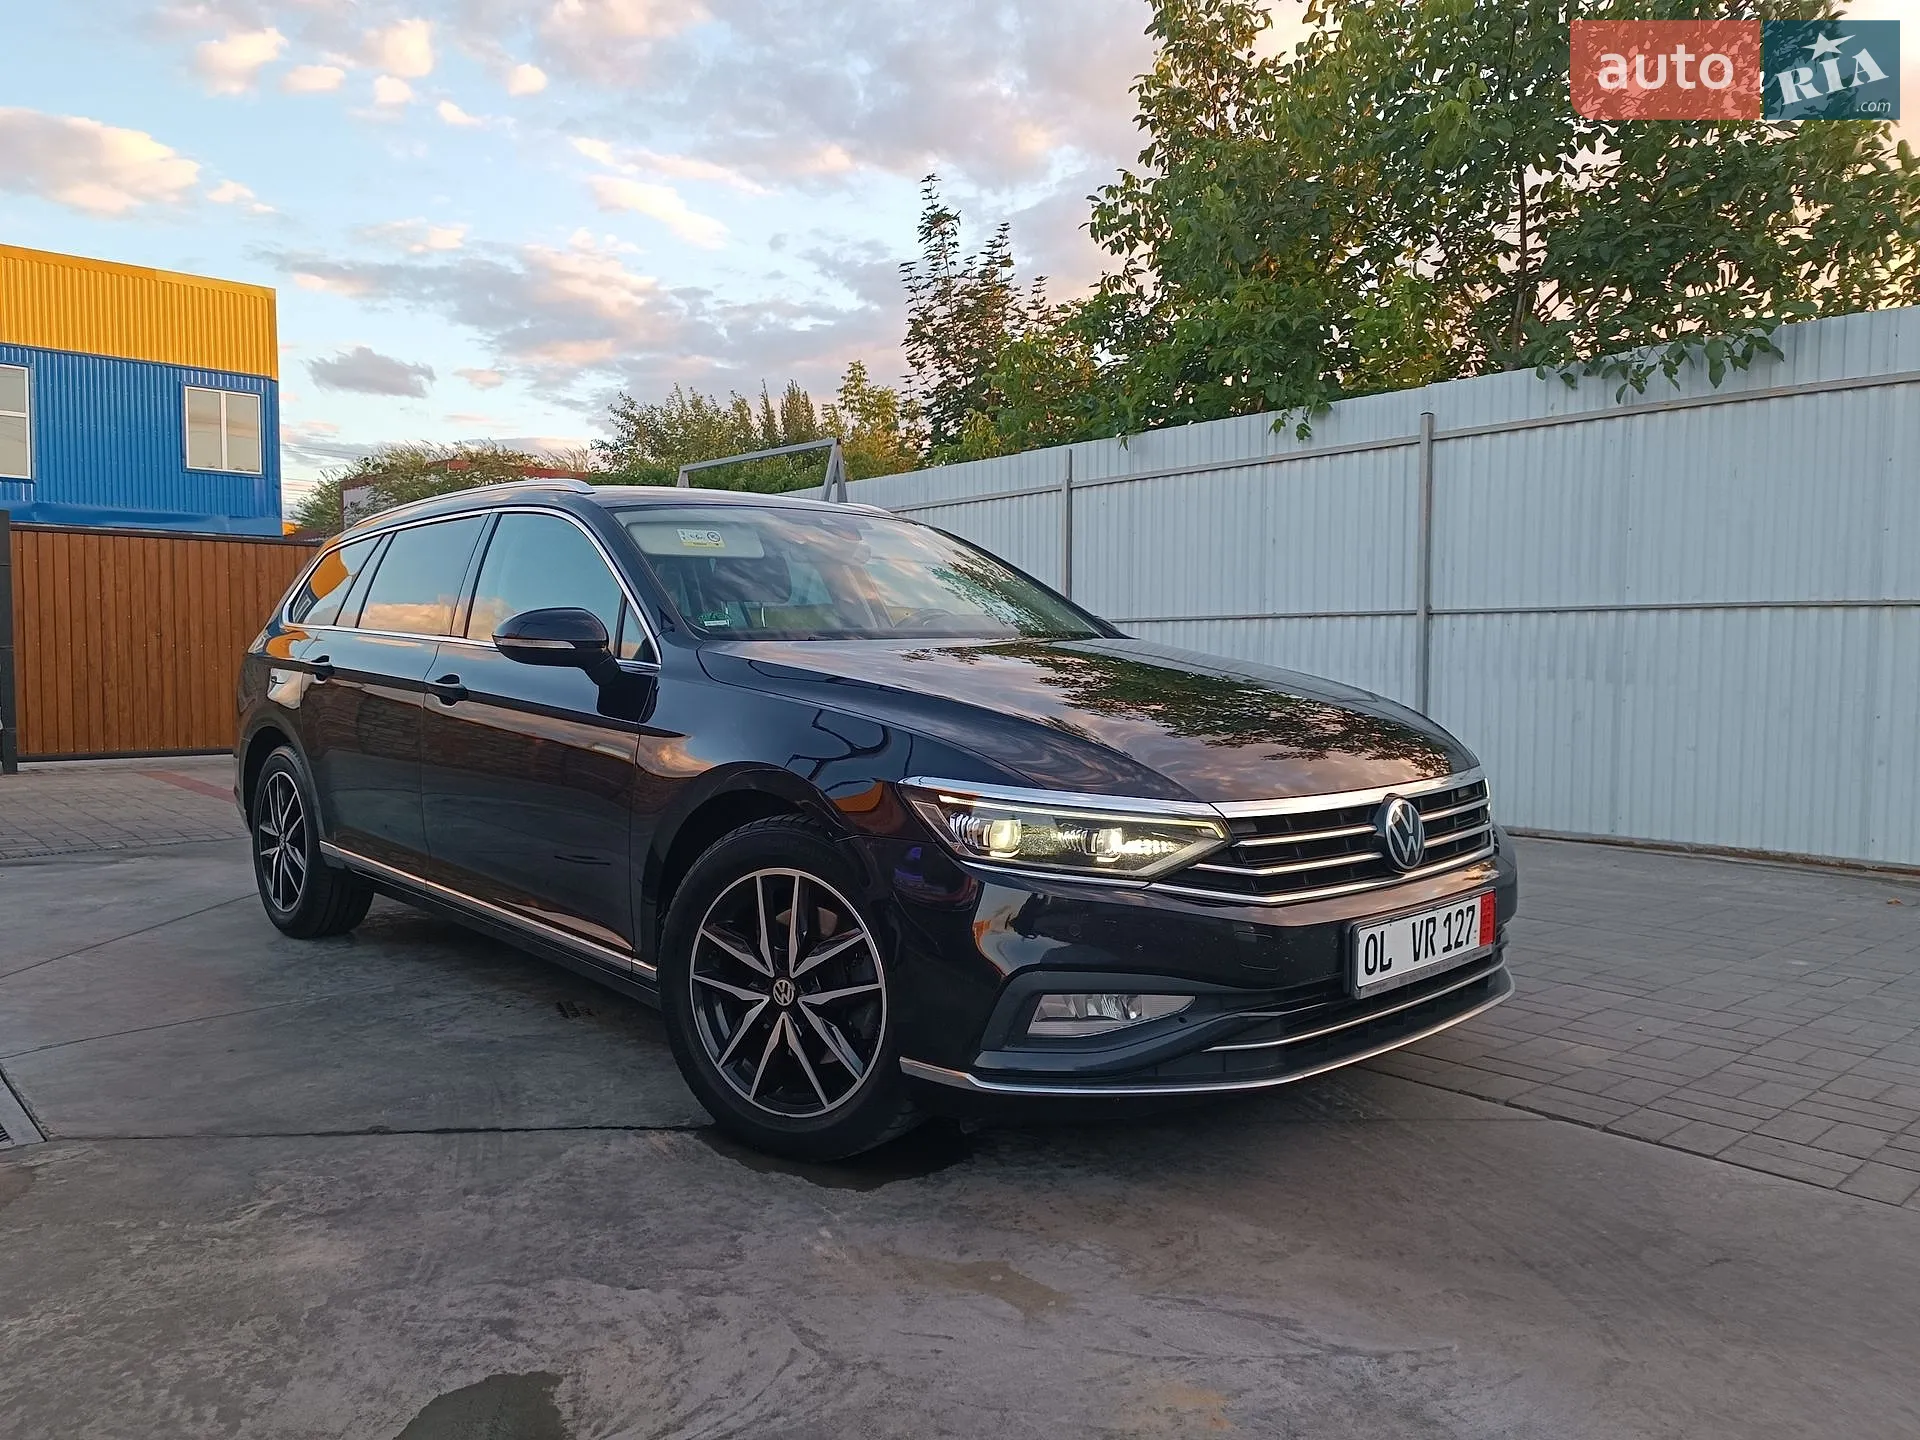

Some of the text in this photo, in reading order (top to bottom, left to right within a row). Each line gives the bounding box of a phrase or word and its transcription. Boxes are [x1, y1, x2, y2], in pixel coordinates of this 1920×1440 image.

[1364, 931, 1392, 975] OL
[1412, 916, 1437, 962] VR
[1441, 904, 1476, 953] 127
